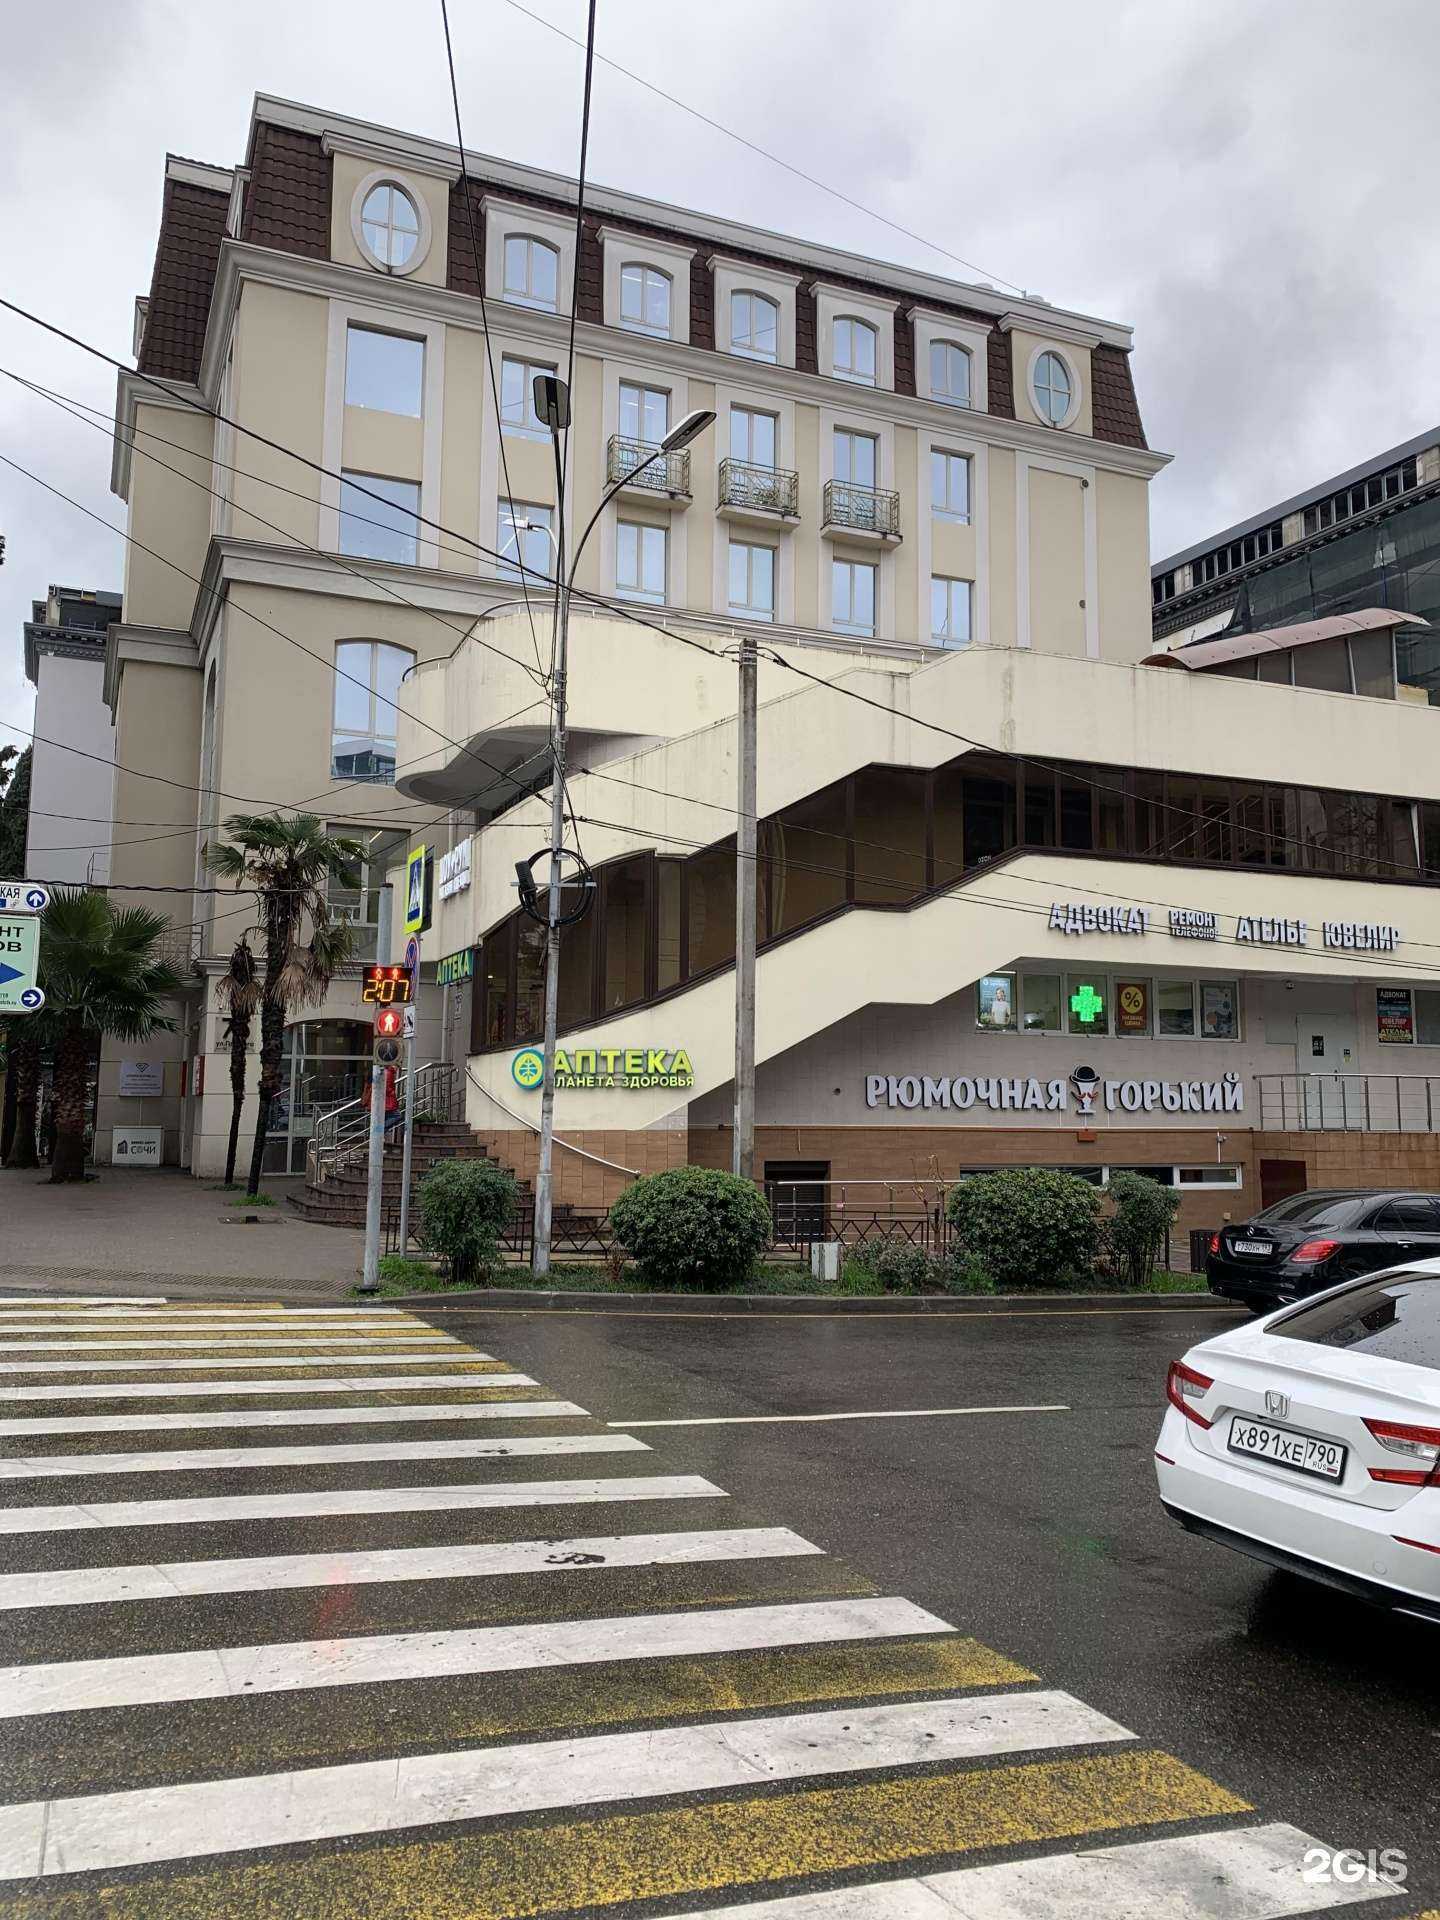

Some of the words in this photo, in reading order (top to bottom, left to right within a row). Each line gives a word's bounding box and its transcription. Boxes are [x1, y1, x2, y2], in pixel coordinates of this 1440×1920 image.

[1050, 903, 1151, 934] АДВОКАТ
[1170, 911, 1218, 926] РЕМОНТ
[1236, 917, 1307, 945] АТЕЛЬЕ
[1324, 922, 1401, 950] ЮВЕЛИР
[437, 949, 471, 985] АПТЕКА
[363, 979, 409, 1002] 2:07
[554, 1049, 694, 1074] АПТЕКА
[554, 1077, 614, 1087] ЛАНЕТА
[622, 1077, 695, 1088] ЗДОРОВЬЯ
[866, 1075, 1066, 1110] РЮМОЧНАЯ
[1104, 1072, 1244, 1111] ГОРЬКИЙ
[1308, 1442, 1336, 1464] 790
[1312, 1461, 1327, 1471] RUS
